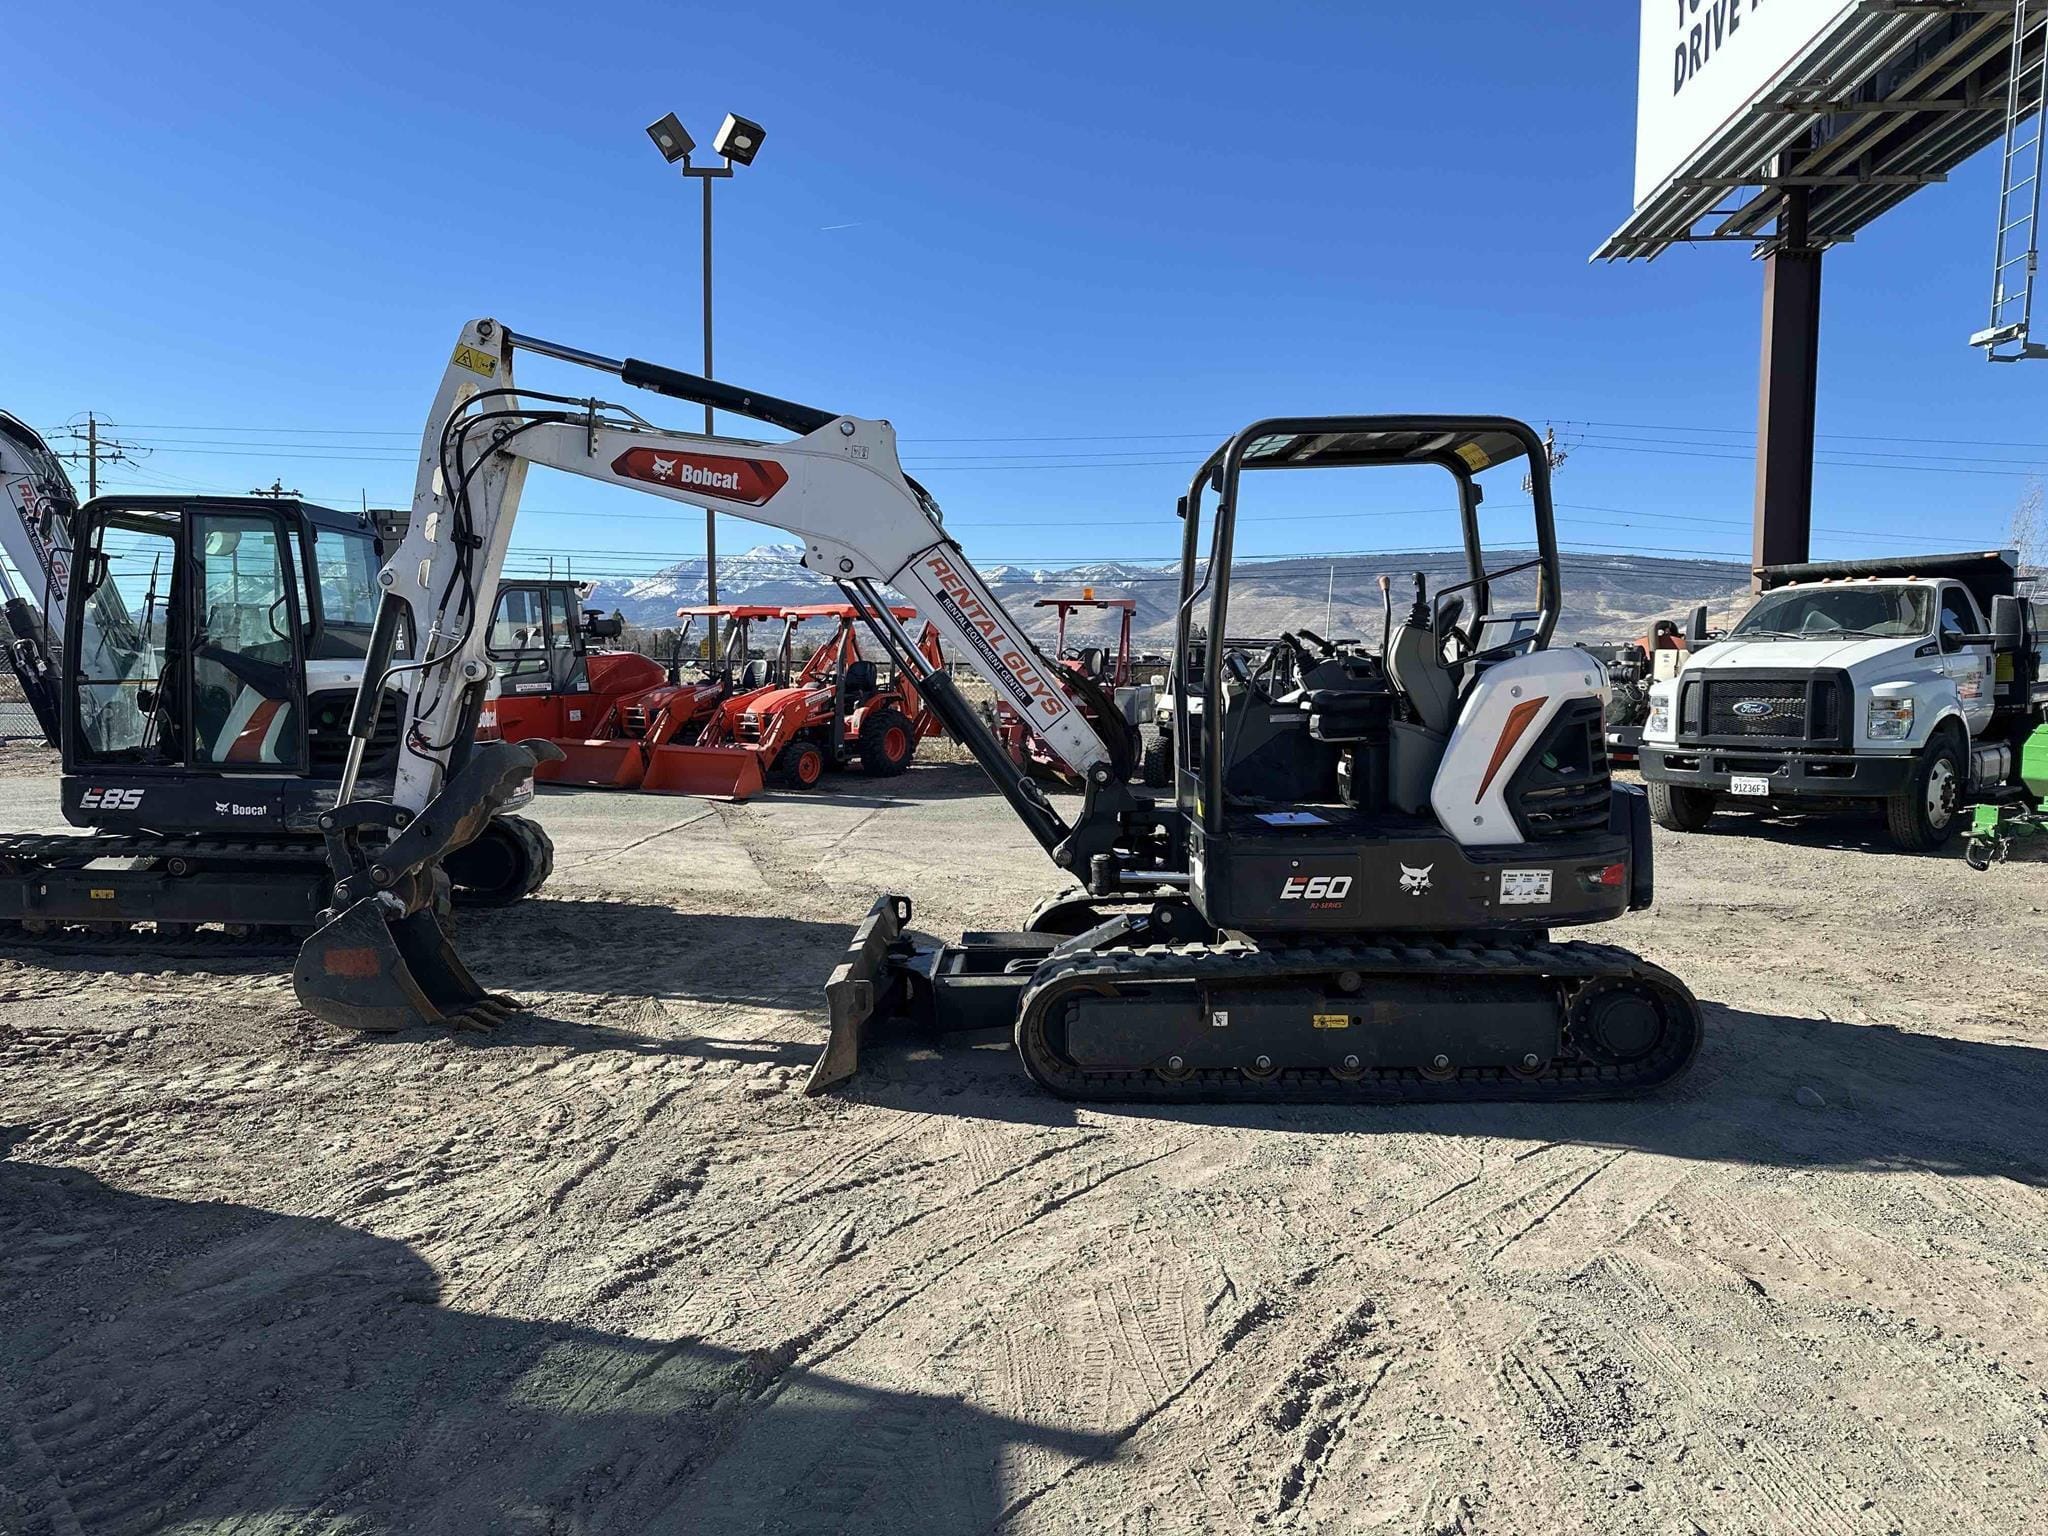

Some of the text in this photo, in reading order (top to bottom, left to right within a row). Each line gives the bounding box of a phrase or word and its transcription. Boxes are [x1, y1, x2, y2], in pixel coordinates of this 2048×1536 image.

[1673, 0, 1741, 97] DRIVE
[681, 464, 740, 490] Bobcat
[926, 557, 1063, 716] RENTAL GUYS
[943, 598, 1027, 700] RENTAL EQUIPMENT CENTER
[1740, 703, 1764, 714] Ford
[80, 788, 145, 810] E85
[1280, 876, 1353, 899] E60
